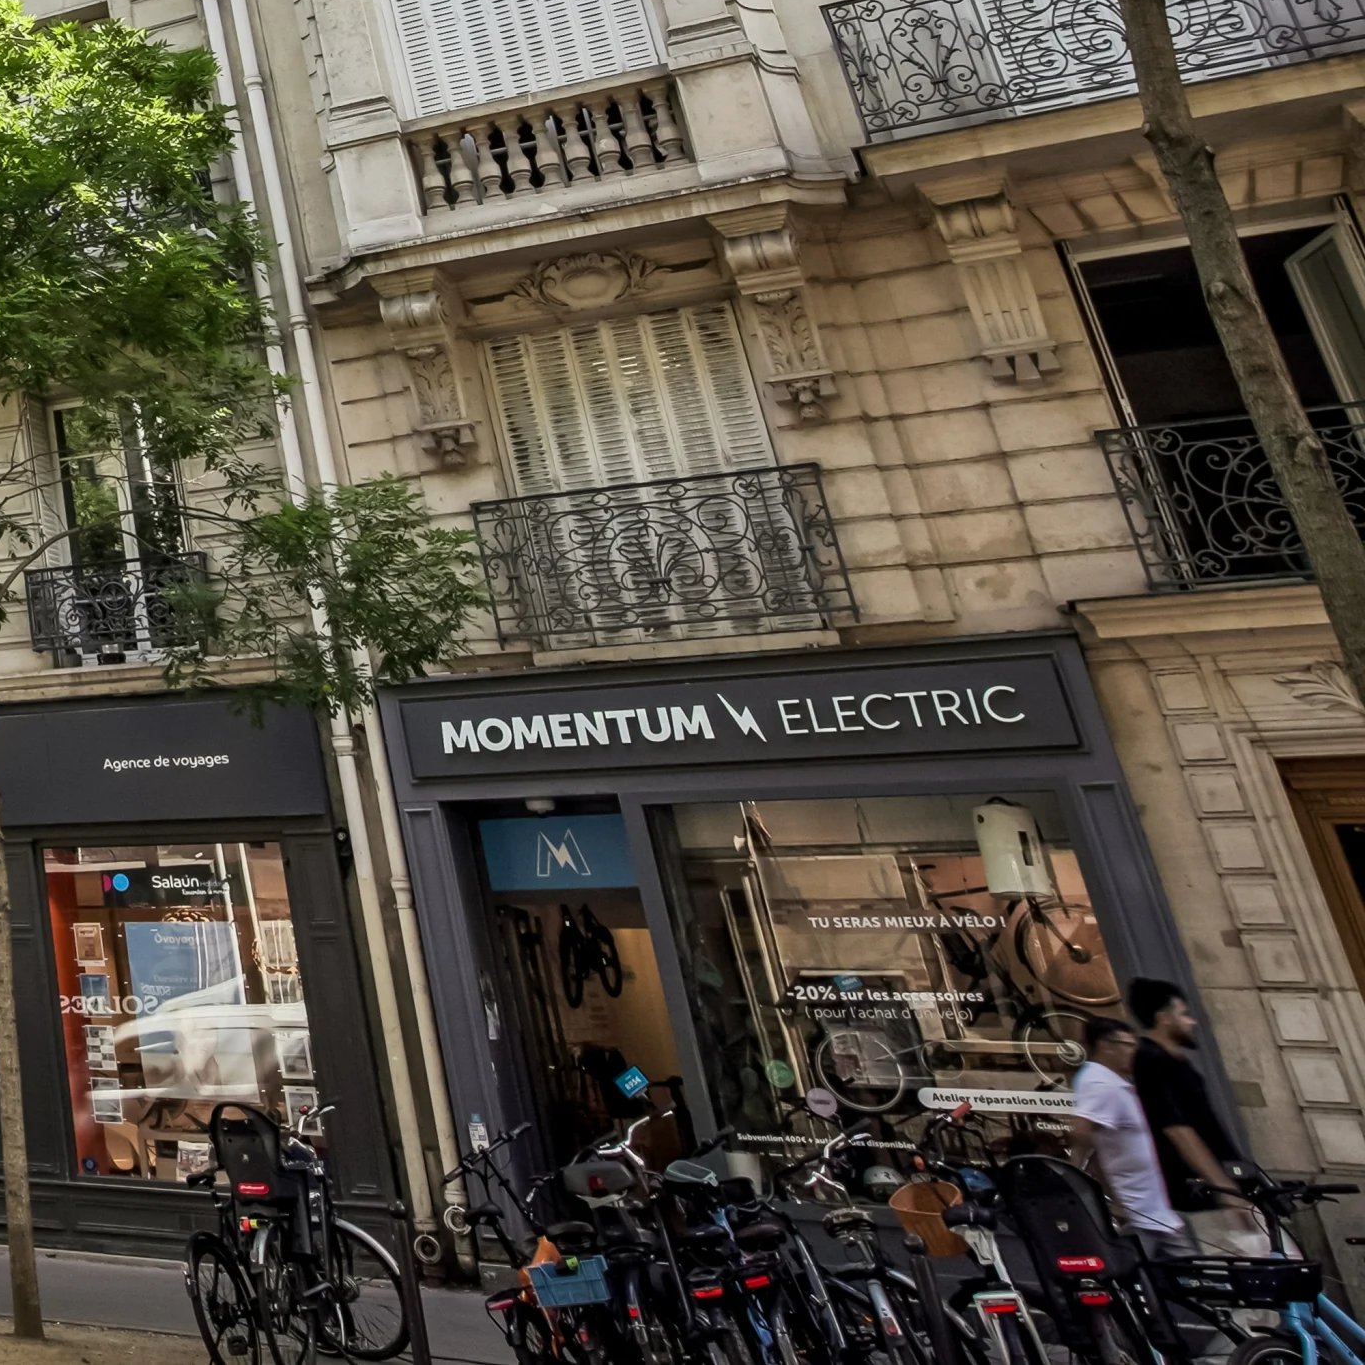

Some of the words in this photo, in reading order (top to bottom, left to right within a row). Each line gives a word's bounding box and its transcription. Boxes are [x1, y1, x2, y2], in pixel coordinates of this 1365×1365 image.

[440, 703, 716, 755] MOMENTUM
[777, 684, 1026, 736] ELECTRIC
[103, 758, 151, 772] Agence
[153, 755, 170, 767] de
[172, 754, 230, 769] voyages
[808, 916, 830, 929] TU
[833, 916, 882, 929] SERAS
[884, 916, 937, 929] MIEUX
[939, 913, 951, 929] À
[952, 913, 997, 929] VÉLO
[1000, 916, 1007, 928] !
[786, 985, 837, 1001] -20%
[839, 991, 865, 1001] sur
[868, 989, 889, 1001] les
[893, 989, 985, 1003] accessoires
[813, 1008, 846, 1022] pour
[850, 1005, 899, 1020] l'achat
[932, 1092, 970, 1104] Atelier
[973, 1095, 1038, 1107] réparation
[1036, 1121, 1071, 1132] Classiq
[736, 1133, 784, 1143] Subvention
[785, 1134, 806, 1144] 400€
[815, 1137, 832, 1145] aut
[866, 1139, 917, 1150] disponibles
